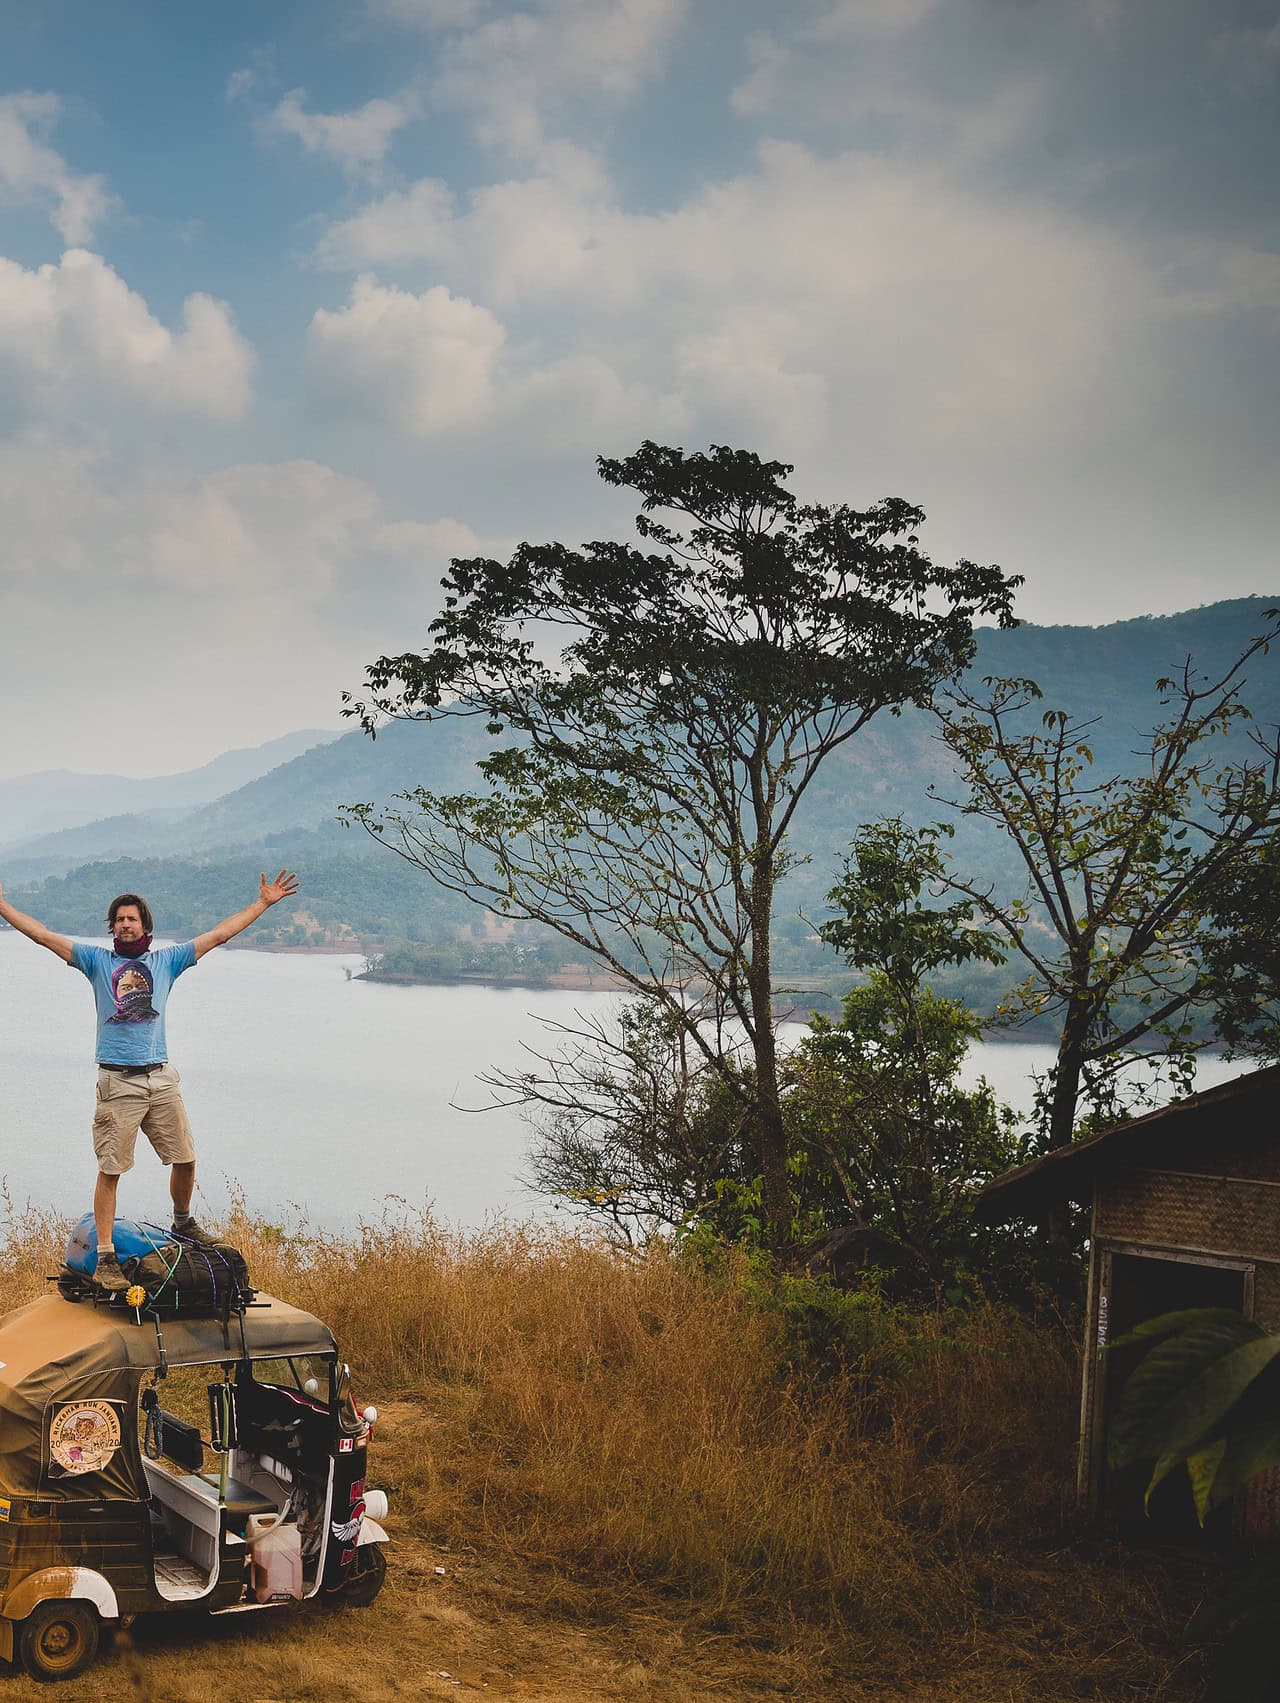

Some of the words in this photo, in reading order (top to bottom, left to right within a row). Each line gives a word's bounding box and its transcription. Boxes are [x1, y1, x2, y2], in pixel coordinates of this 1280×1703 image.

[53, 1403, 80, 1435] RICKSHAW
[99, 1405, 118, 1434] JANUARY
[51, 1440, 61, 1448] 20
[109, 1438, 120, 1447] 20
